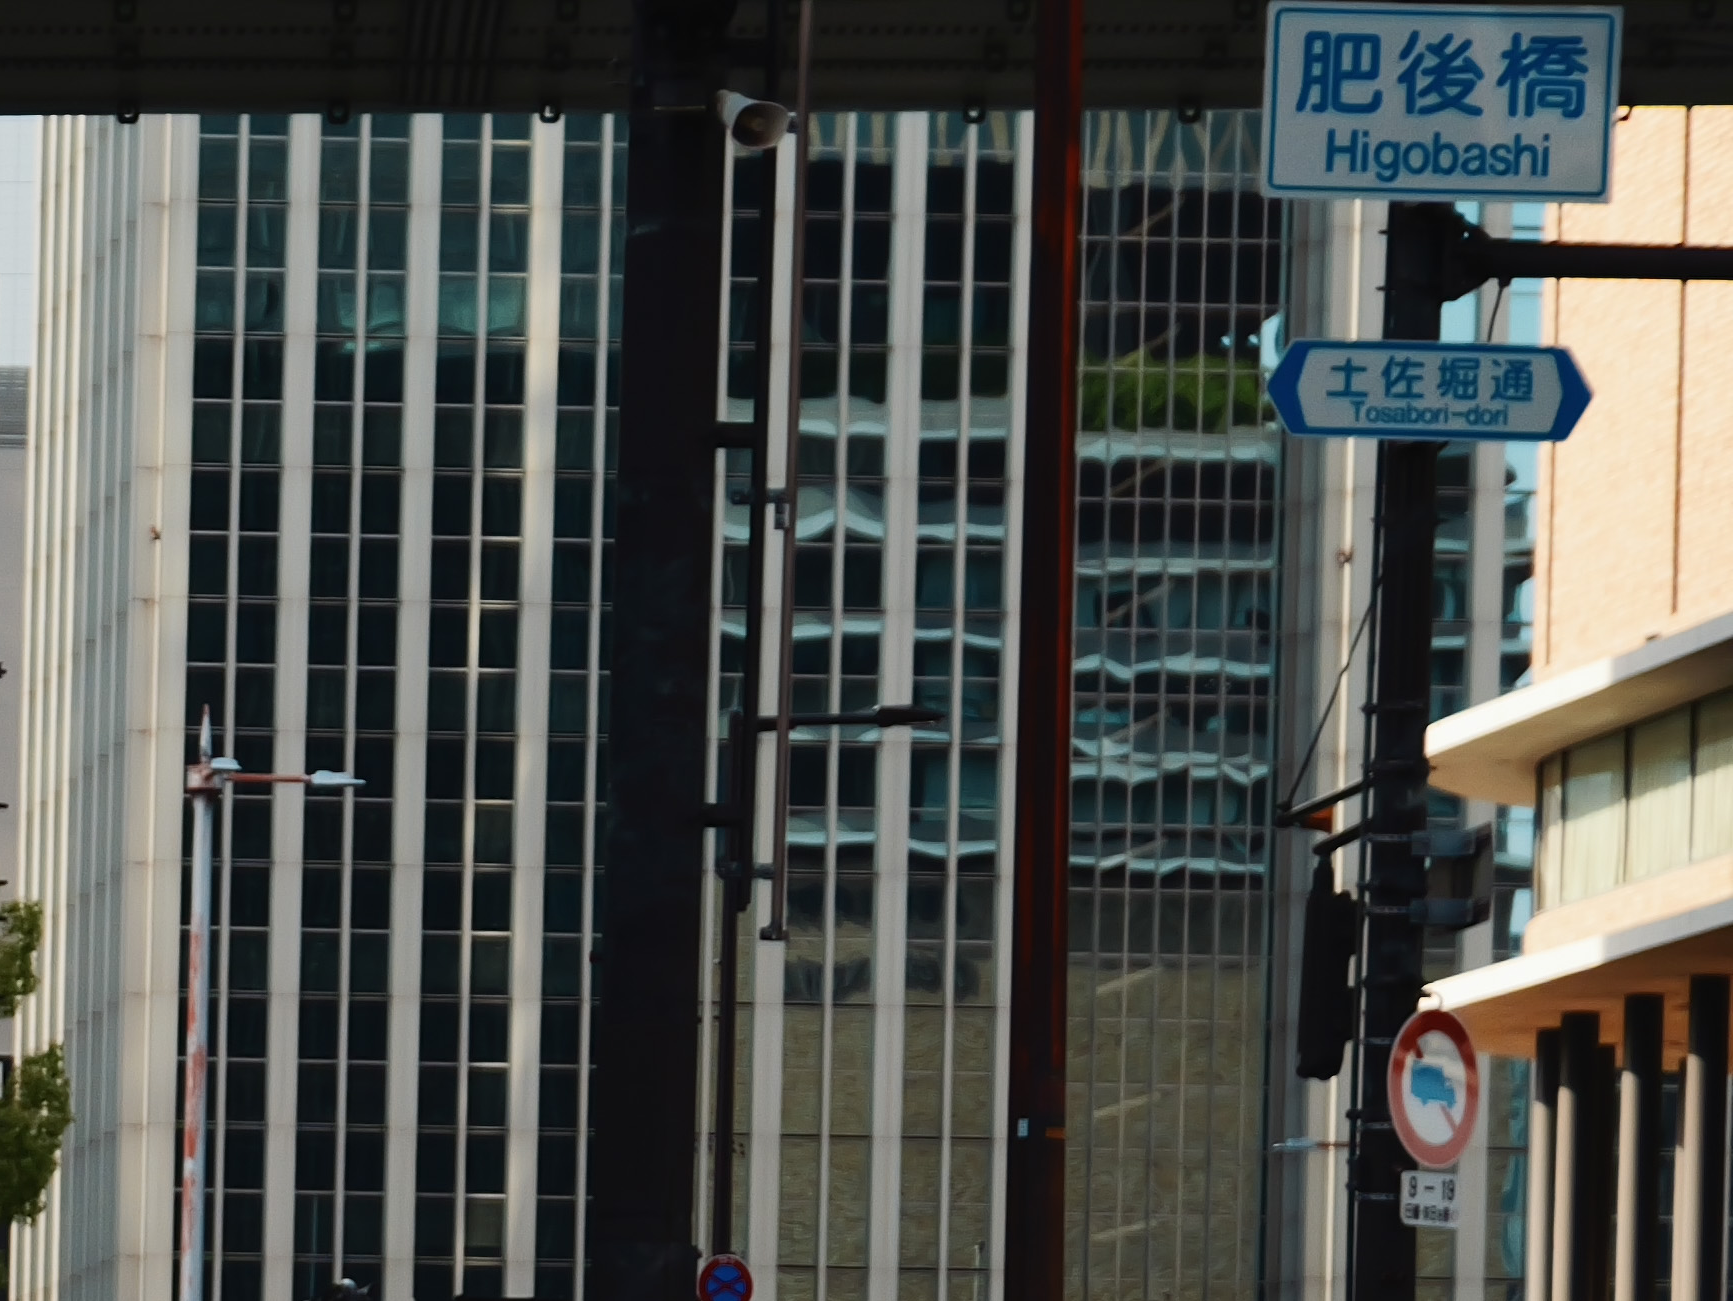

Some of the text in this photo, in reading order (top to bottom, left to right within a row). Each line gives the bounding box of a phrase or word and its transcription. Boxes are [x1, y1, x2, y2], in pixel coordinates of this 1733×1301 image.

[1295, 31, 1588, 119] 肥後橋
[1326, 129, 1551, 182] Higobashi
[1326, 355, 1533, 402] 土佐堀通
[1349, 400, 1509, 427] Tosabori-dori
